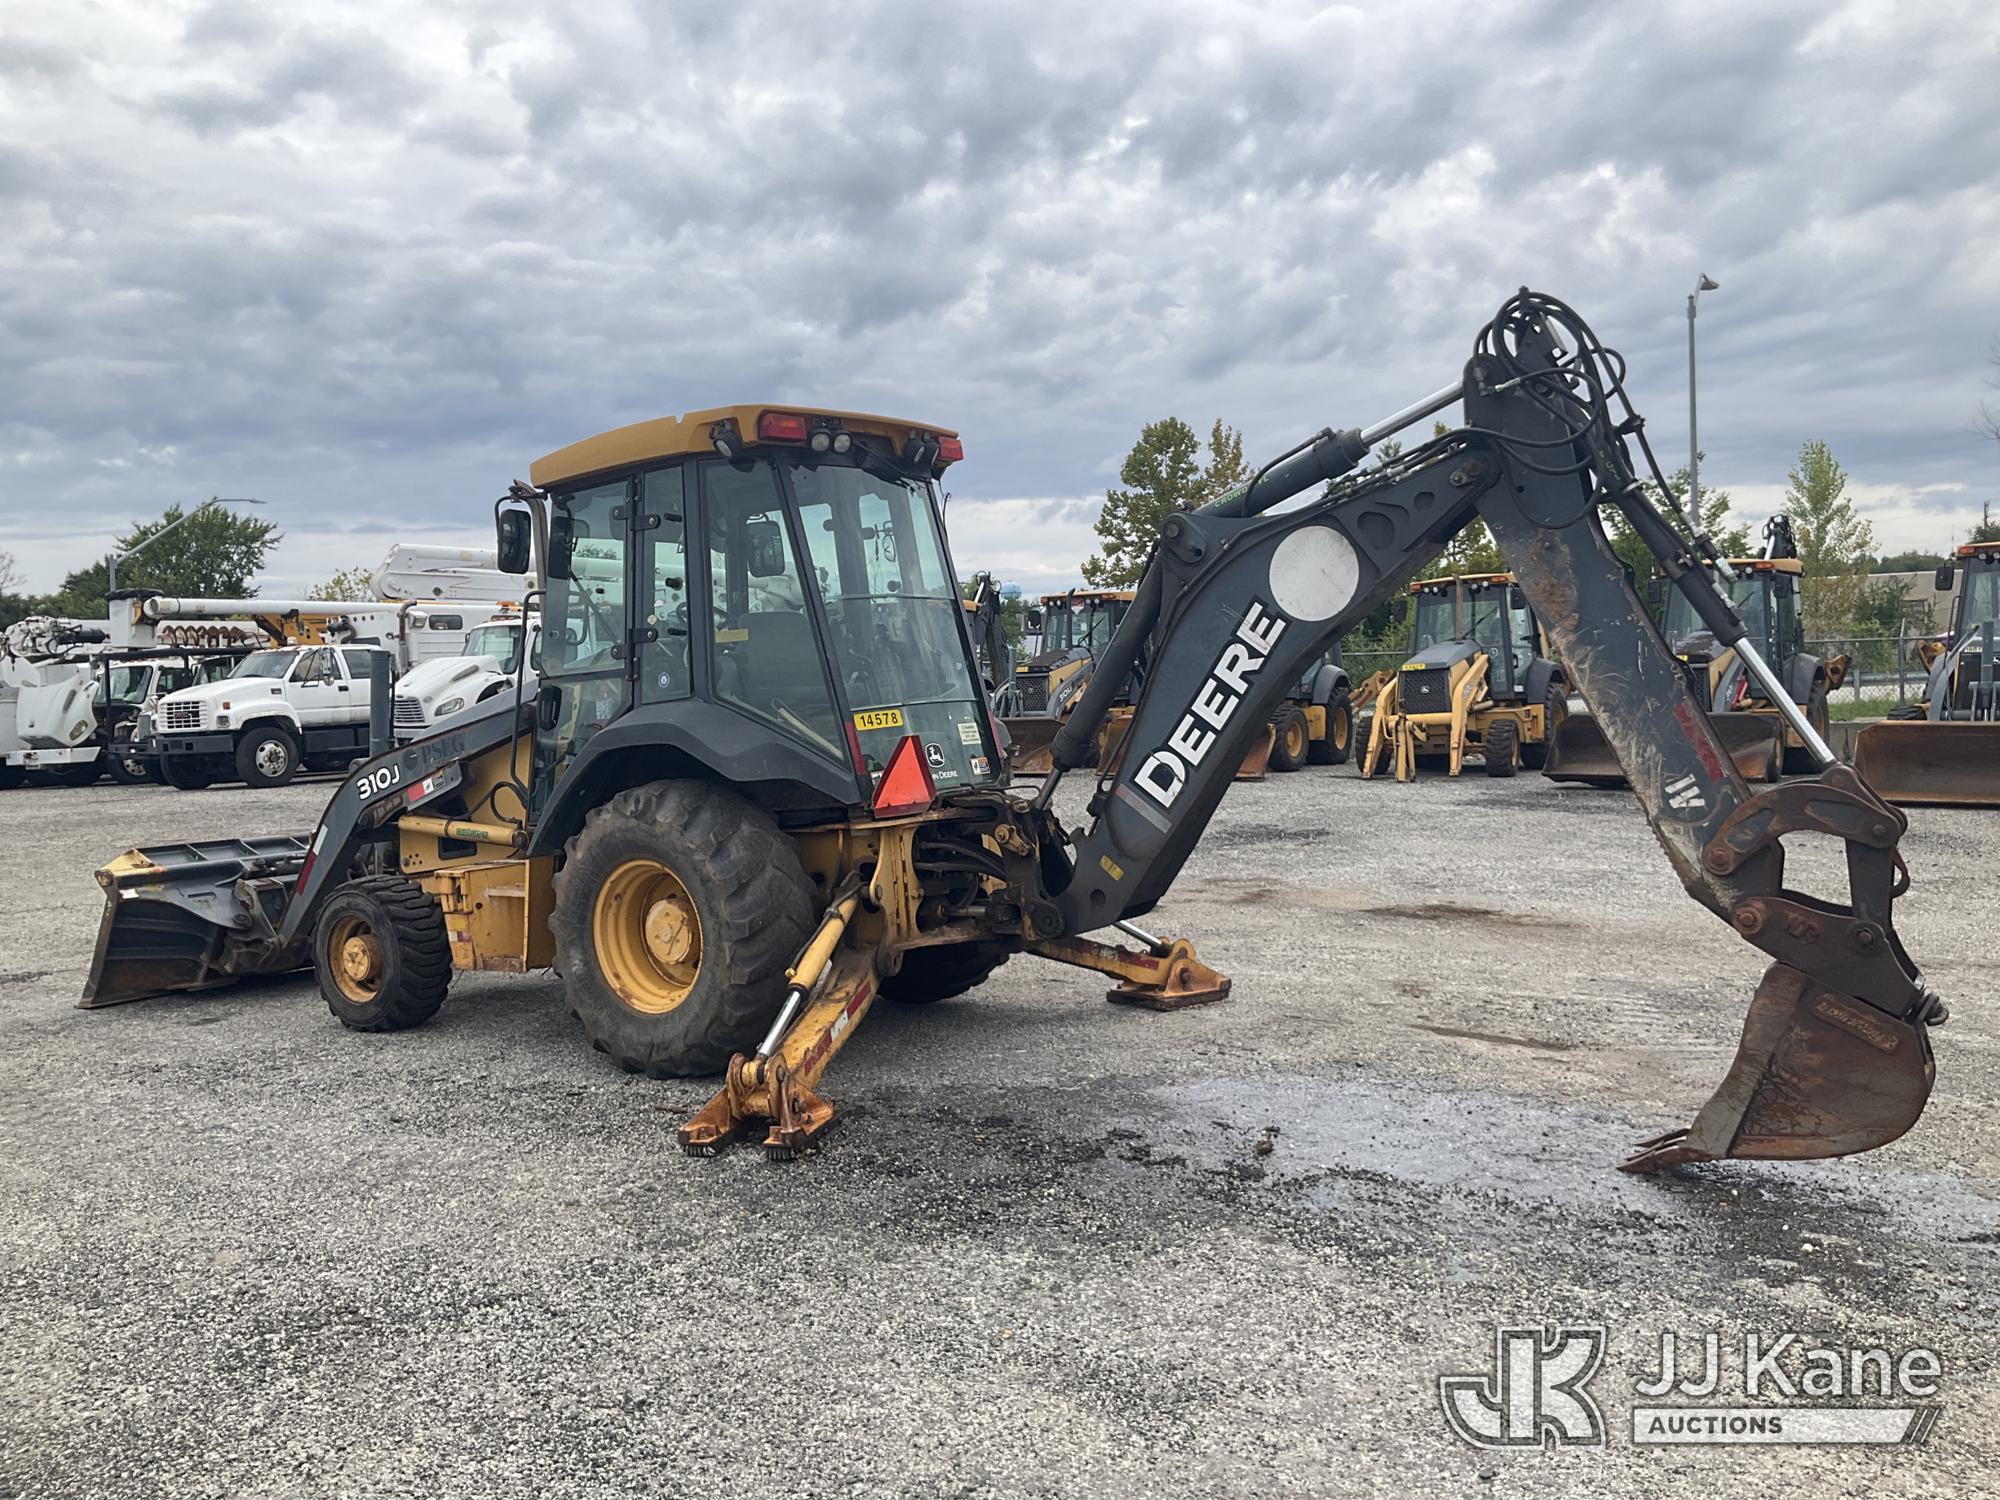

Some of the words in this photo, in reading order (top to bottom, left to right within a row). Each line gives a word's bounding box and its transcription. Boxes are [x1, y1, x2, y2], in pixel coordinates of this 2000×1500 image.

[1214, 486, 1248, 508] CROWD
[1134, 602, 1286, 808] DEERE
[860, 712, 898, 727] 14578
[357, 765, 400, 800] 310J
[939, 770, 959, 780] DEERE
